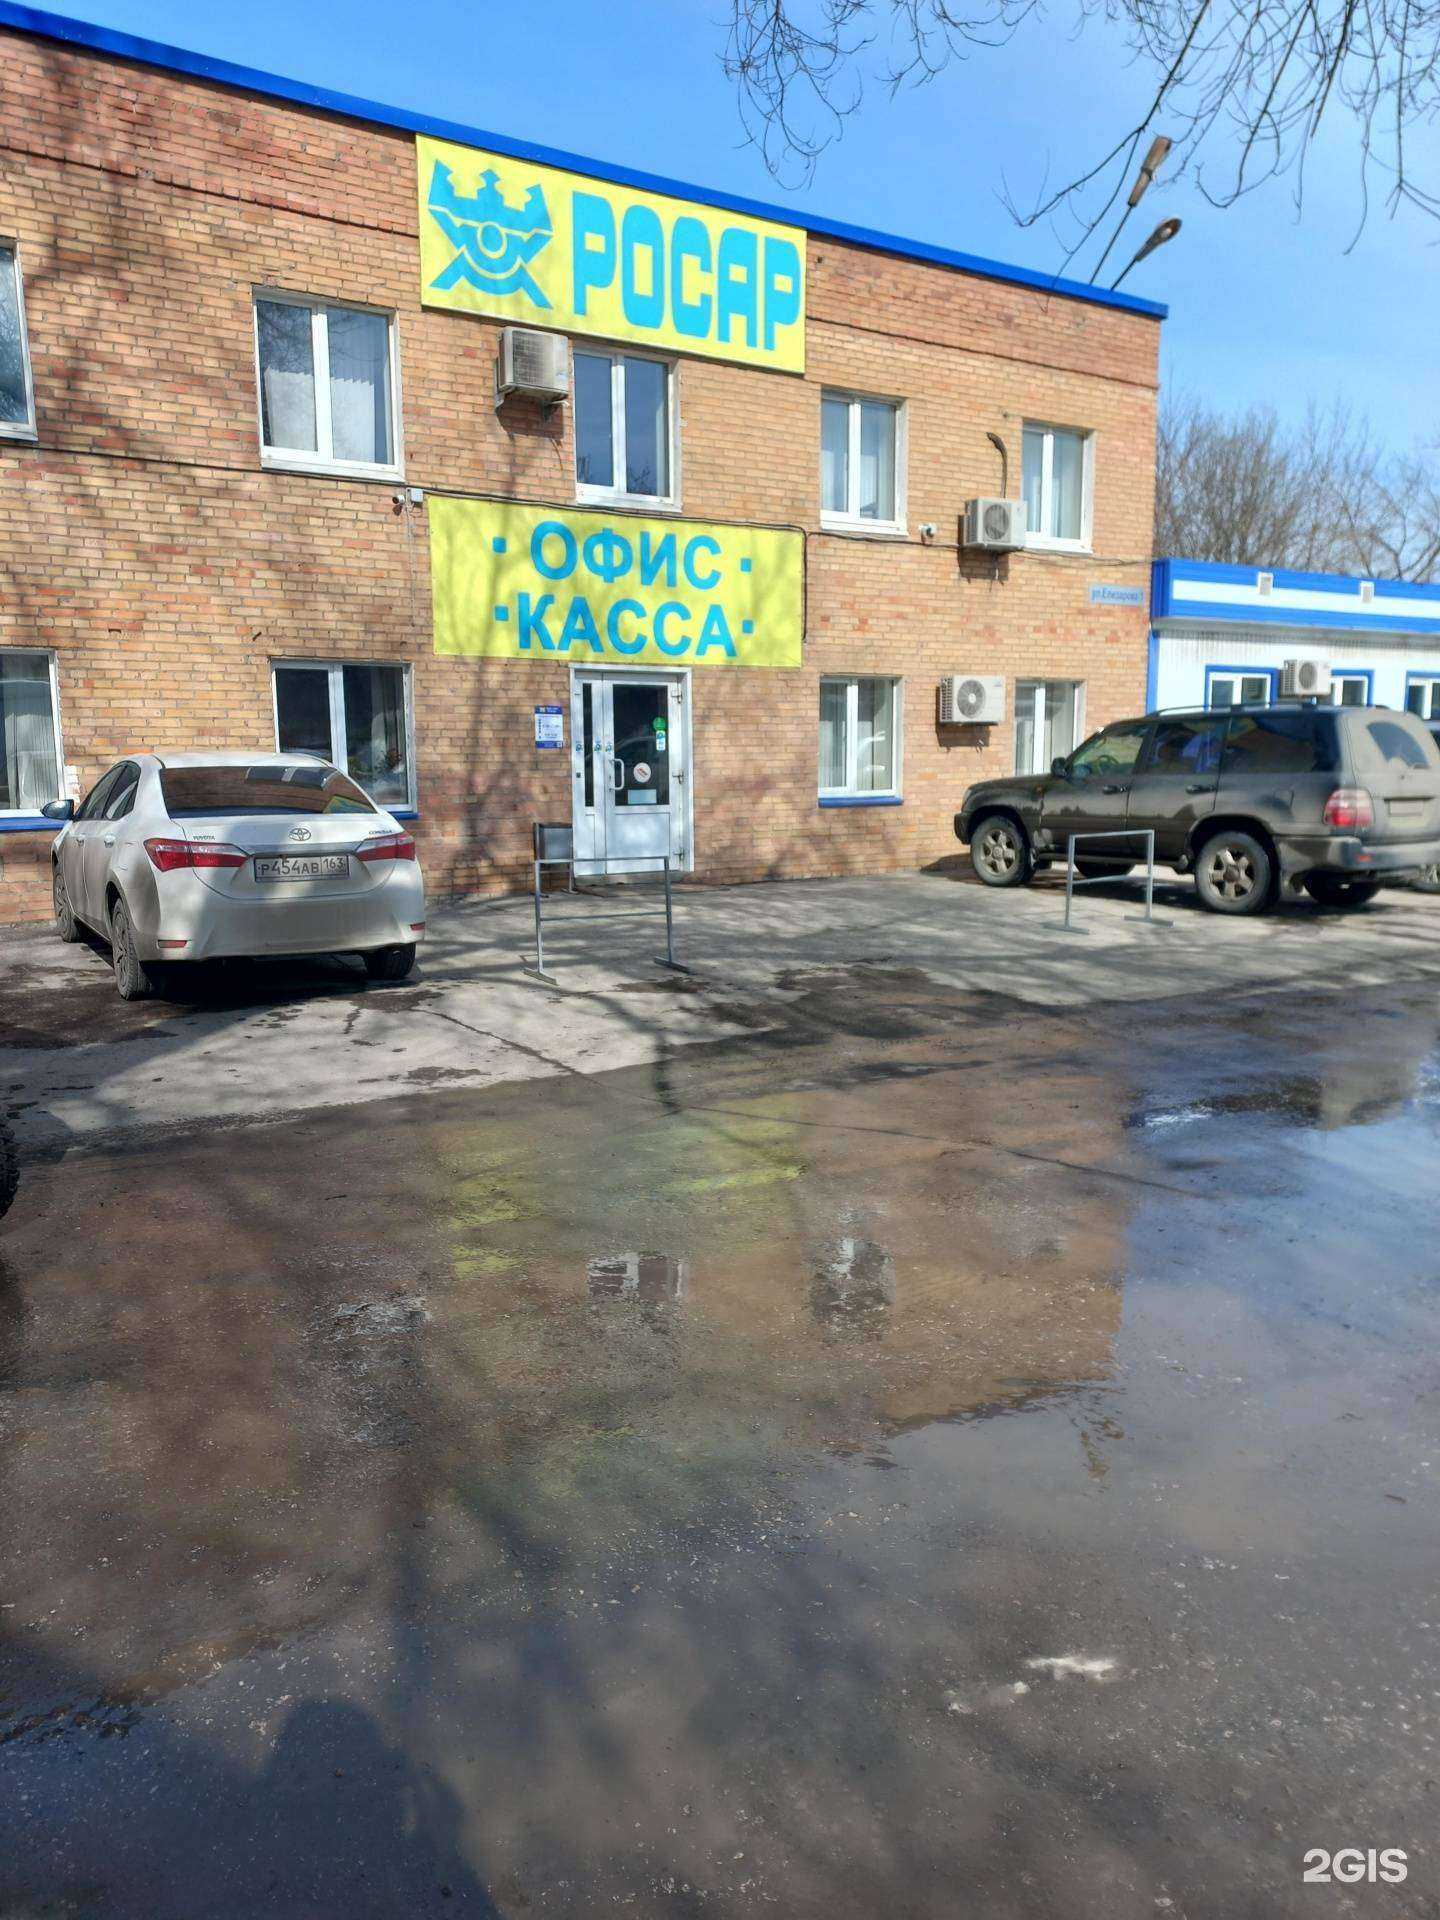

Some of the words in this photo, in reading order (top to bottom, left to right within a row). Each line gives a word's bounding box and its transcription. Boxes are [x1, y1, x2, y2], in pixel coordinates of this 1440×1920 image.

[573, 191, 800, 351] РОСАР
[530, 520, 722, 591] ОФИС
[518, 592, 737, 658] КАССА
